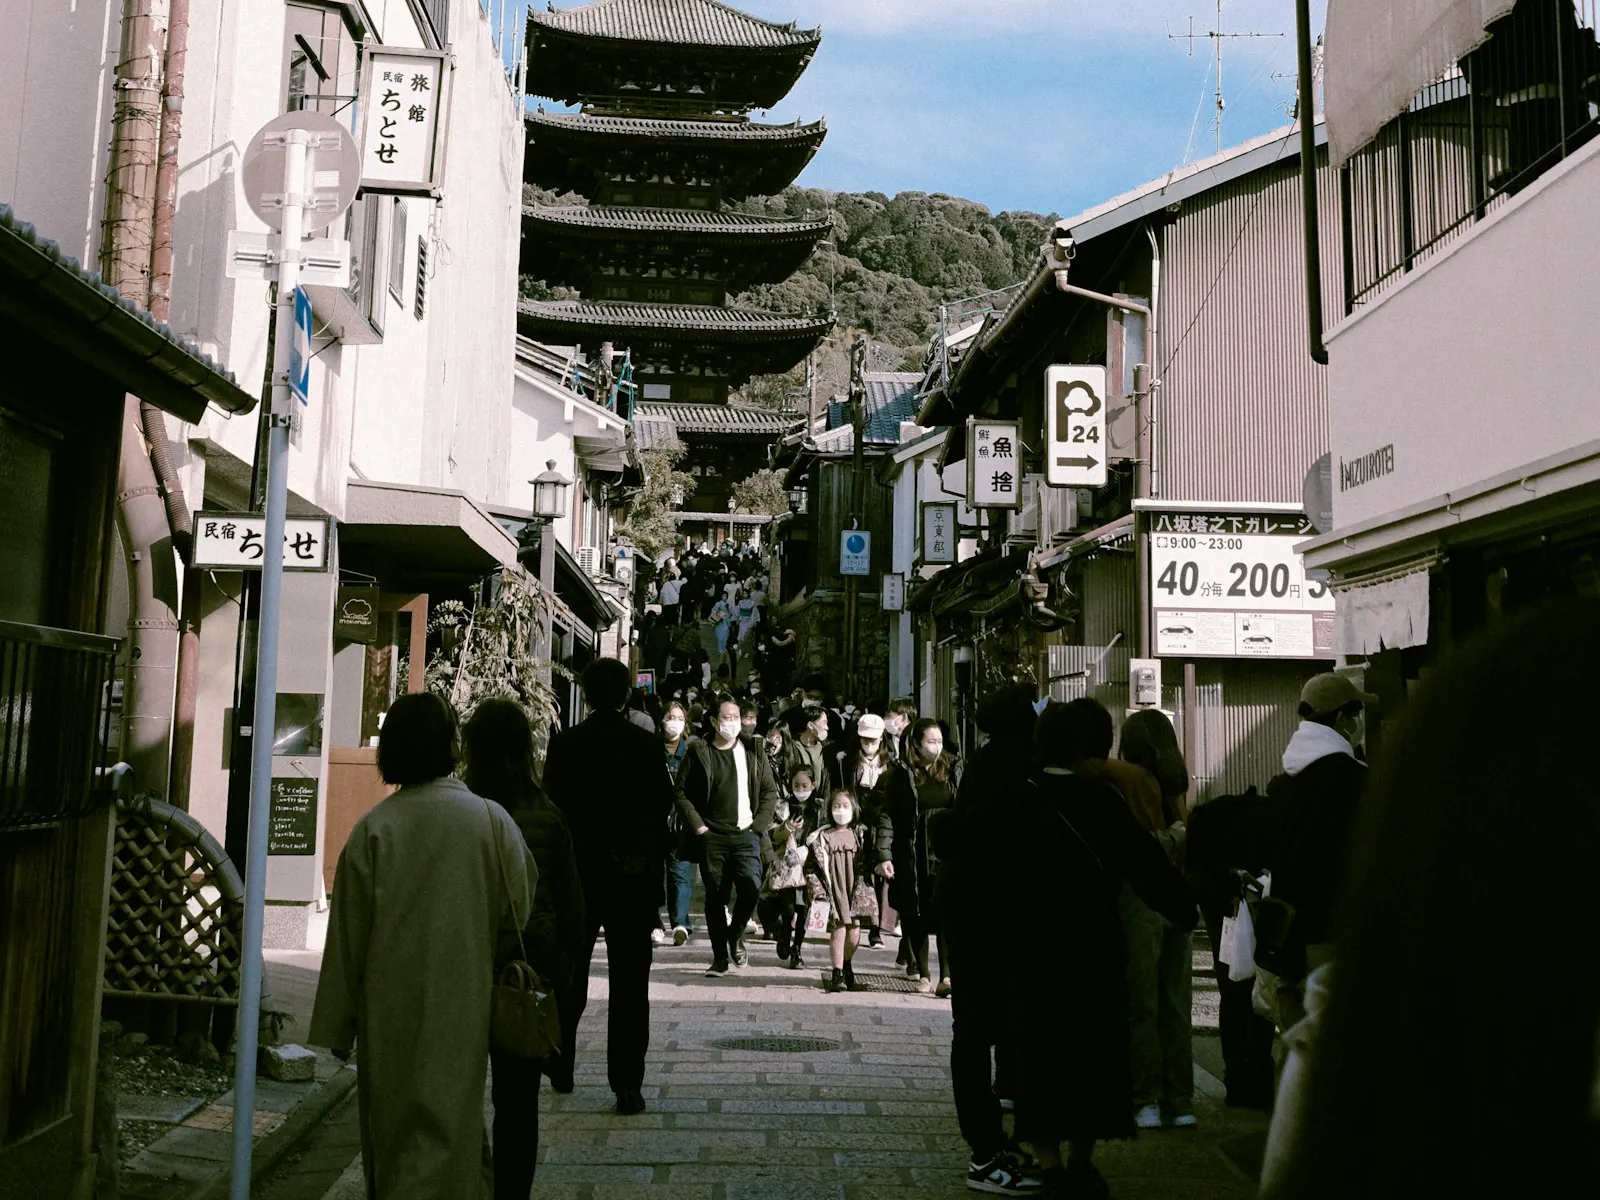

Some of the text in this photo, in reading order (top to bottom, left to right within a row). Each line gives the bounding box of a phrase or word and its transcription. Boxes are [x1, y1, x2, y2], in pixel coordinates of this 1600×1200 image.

[383, 71, 404, 84] 民宿
[408, 73, 430, 123] 旅館
[374, 88, 401, 164] ちとせ
[978, 429, 990, 459] 鮮魚
[1072, 425, 1099, 443] 24
[991, 437, 1013, 493] 魚捨
[1344, 443, 1395, 491] MIZUIROTEI
[204, 522, 319, 560] 民宿 ちせ
